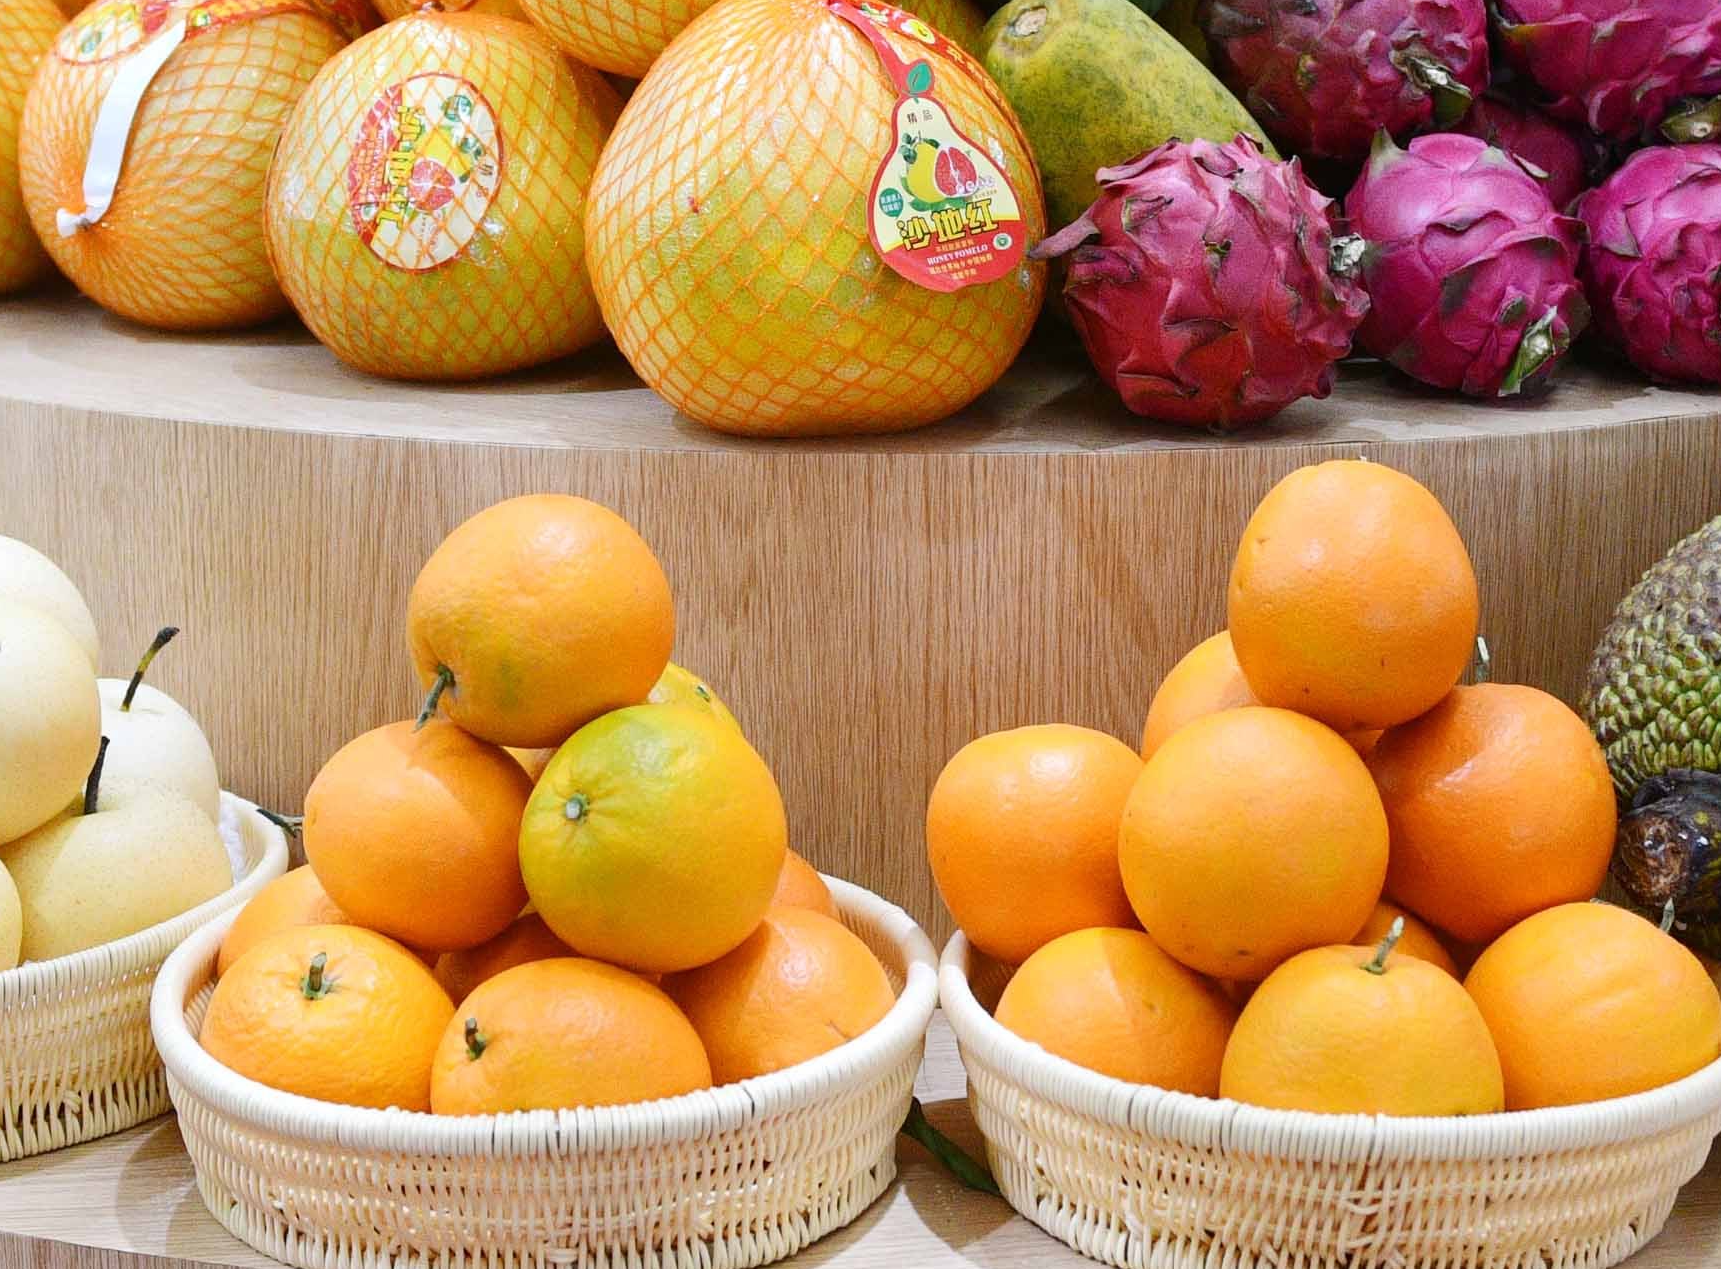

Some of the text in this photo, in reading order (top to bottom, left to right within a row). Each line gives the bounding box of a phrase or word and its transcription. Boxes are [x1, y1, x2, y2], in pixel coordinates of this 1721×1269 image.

[897, 198, 998, 251] 沙地红
[926, 251, 954, 266] HONEY
[954, 243, 989, 259] POMELO
